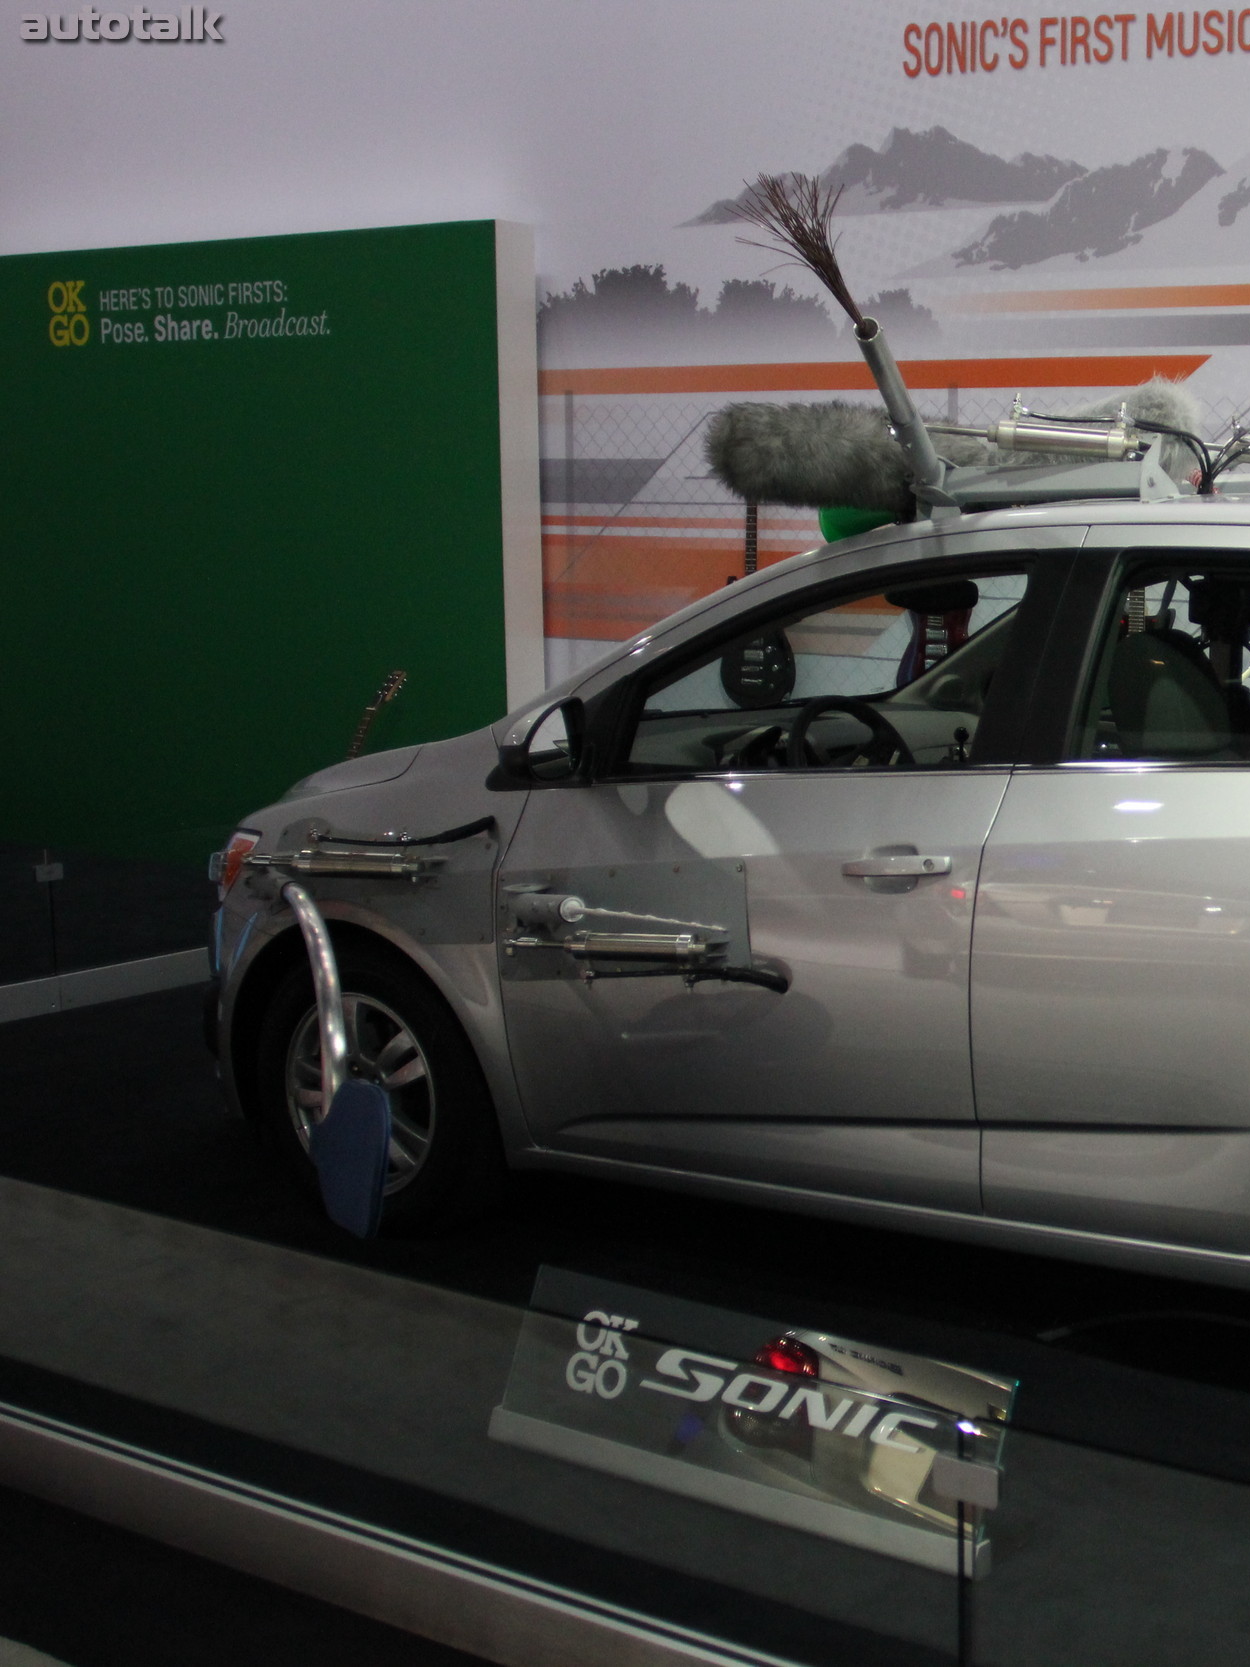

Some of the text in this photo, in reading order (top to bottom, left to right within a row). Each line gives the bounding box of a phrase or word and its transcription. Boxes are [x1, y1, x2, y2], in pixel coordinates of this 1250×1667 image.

[903, 17, 1029, 77] SONIC'S
[1039, 13, 1136, 67] FIRST
[48, 280, 87, 313] OK
[100, 280, 288, 312] HERE'S TO SONIC FIRSTS:
[49, 314, 90, 347] GO
[100, 307, 331, 344] Pose. Share. Broadcast.
[576, 1311, 640, 1360] OK
[565, 1351, 628, 1400] GO
[640, 1348, 938, 1454] SONIC
